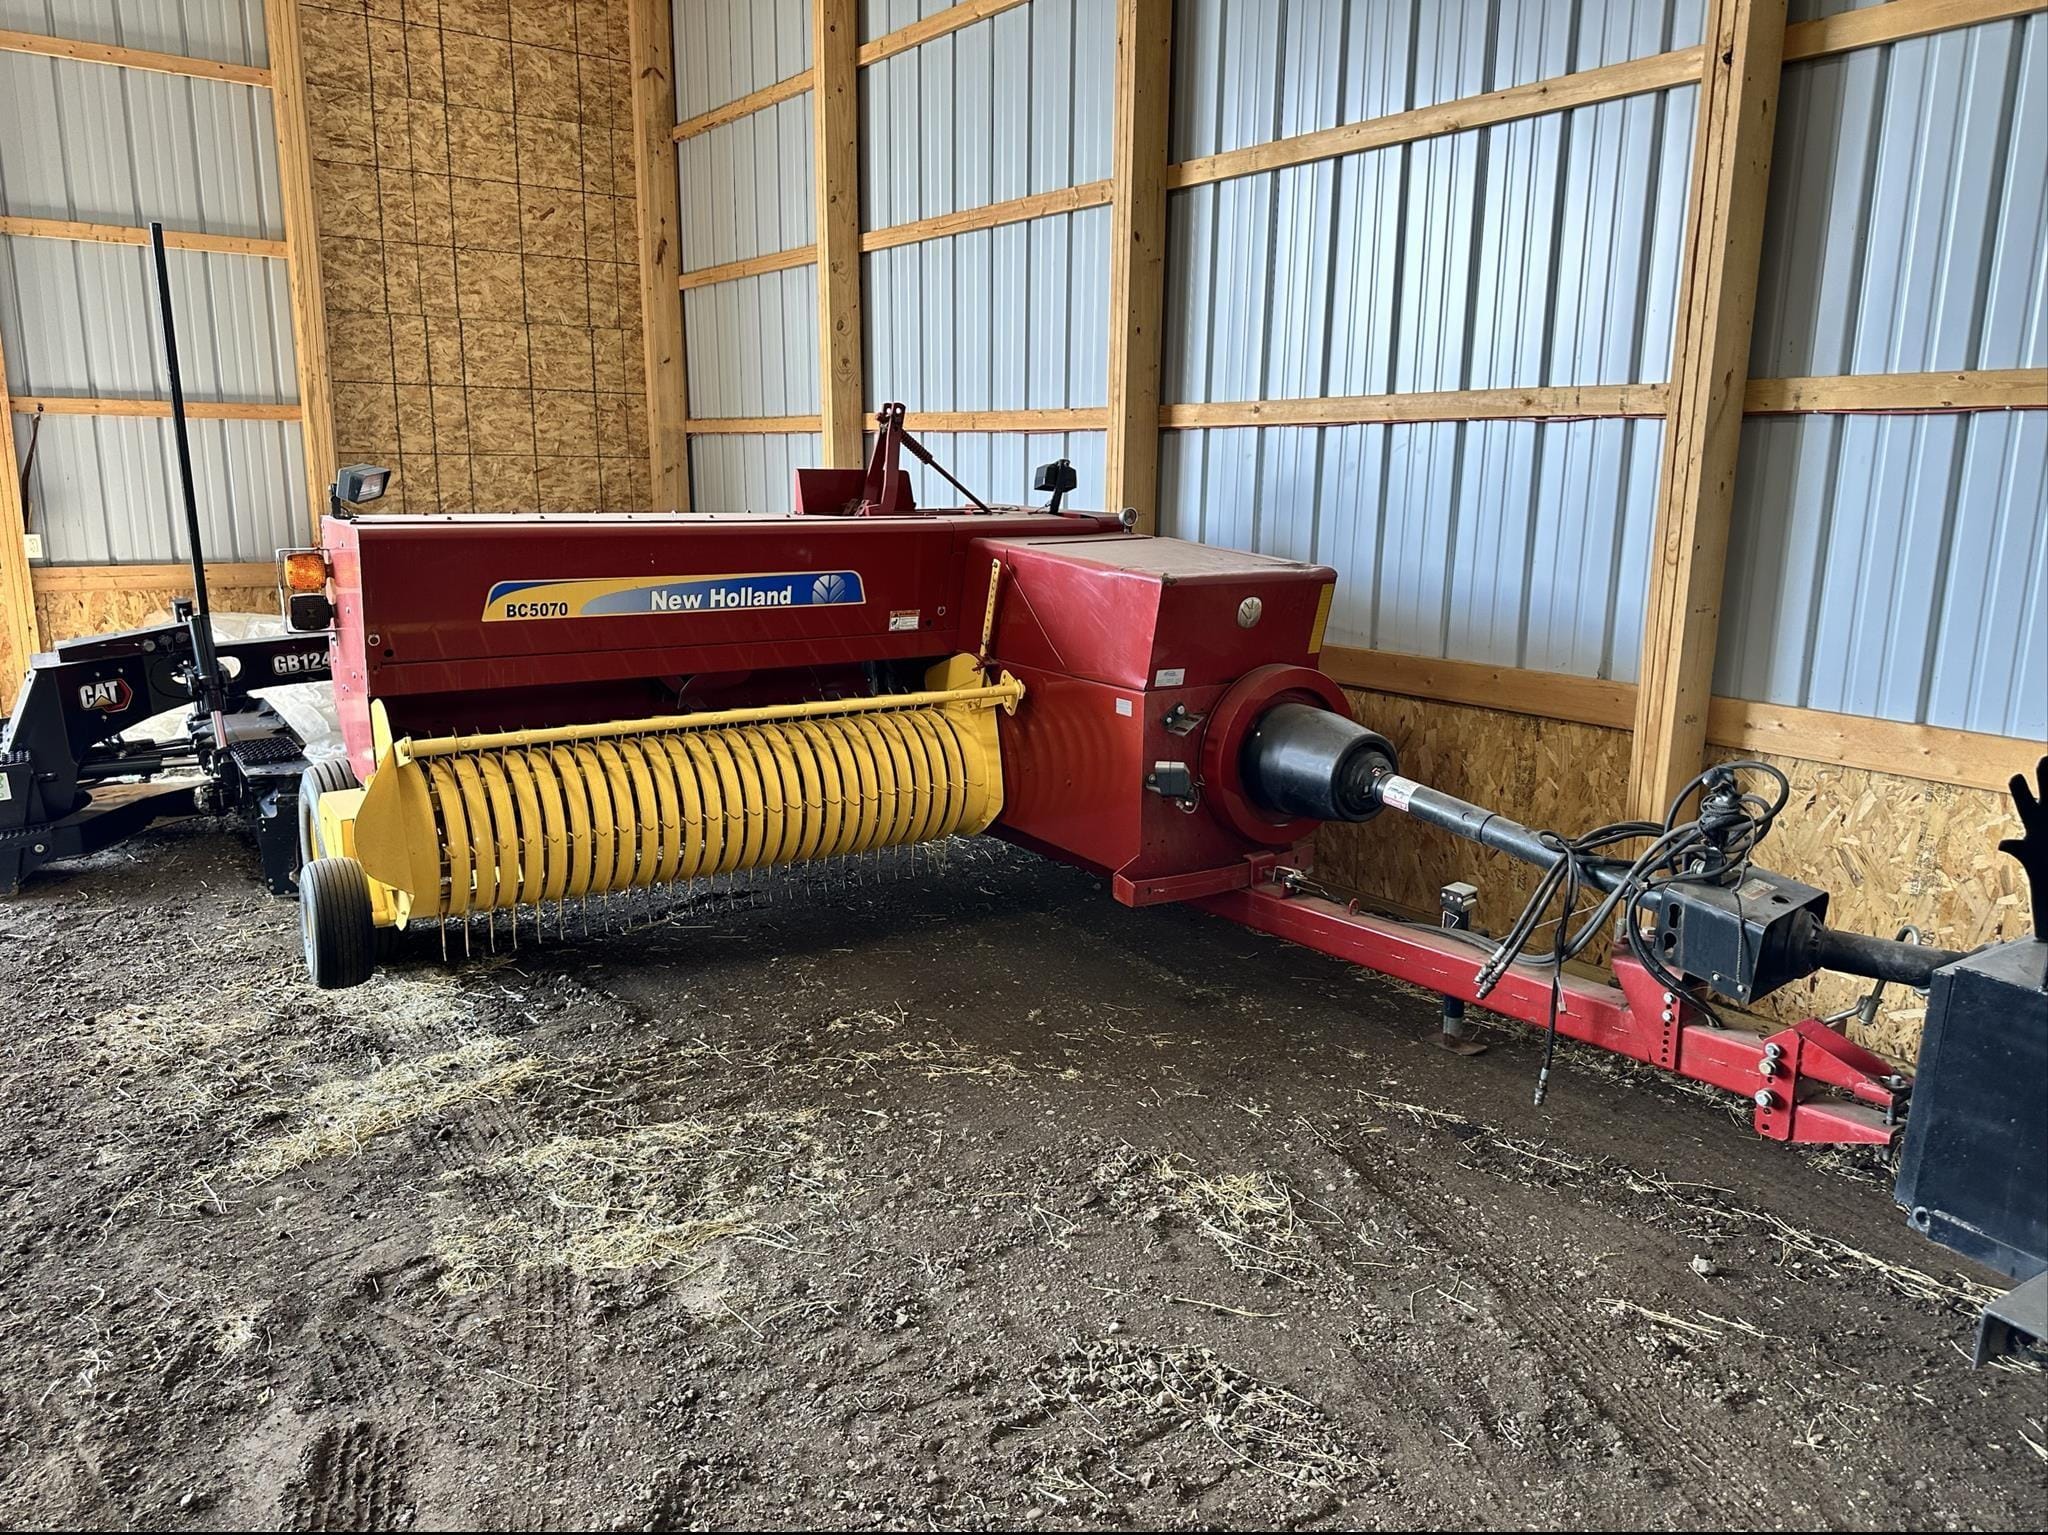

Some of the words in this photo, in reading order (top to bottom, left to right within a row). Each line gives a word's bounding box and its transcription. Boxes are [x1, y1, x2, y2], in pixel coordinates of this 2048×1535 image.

[506, 602, 568, 618] BC5070
[651, 590, 703, 611] New
[709, 585, 792, 608] Holland
[80, 681, 118, 709] CAT
